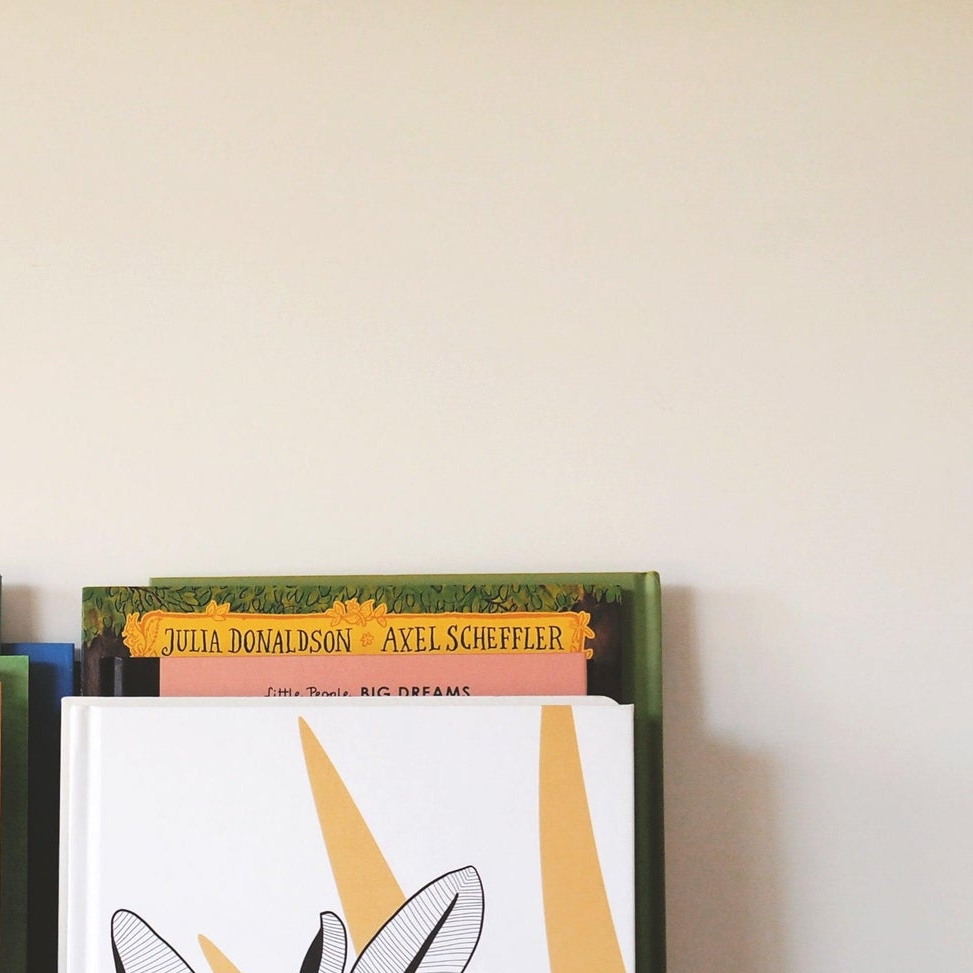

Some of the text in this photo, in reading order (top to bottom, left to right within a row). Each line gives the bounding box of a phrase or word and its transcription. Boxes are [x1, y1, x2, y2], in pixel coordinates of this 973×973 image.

[161, 624, 565, 657] JULIA DONALDSON AXEL SCHEFFLER
[360, 686, 391, 697] BIG
[398, 686, 471, 697] DREAMS
